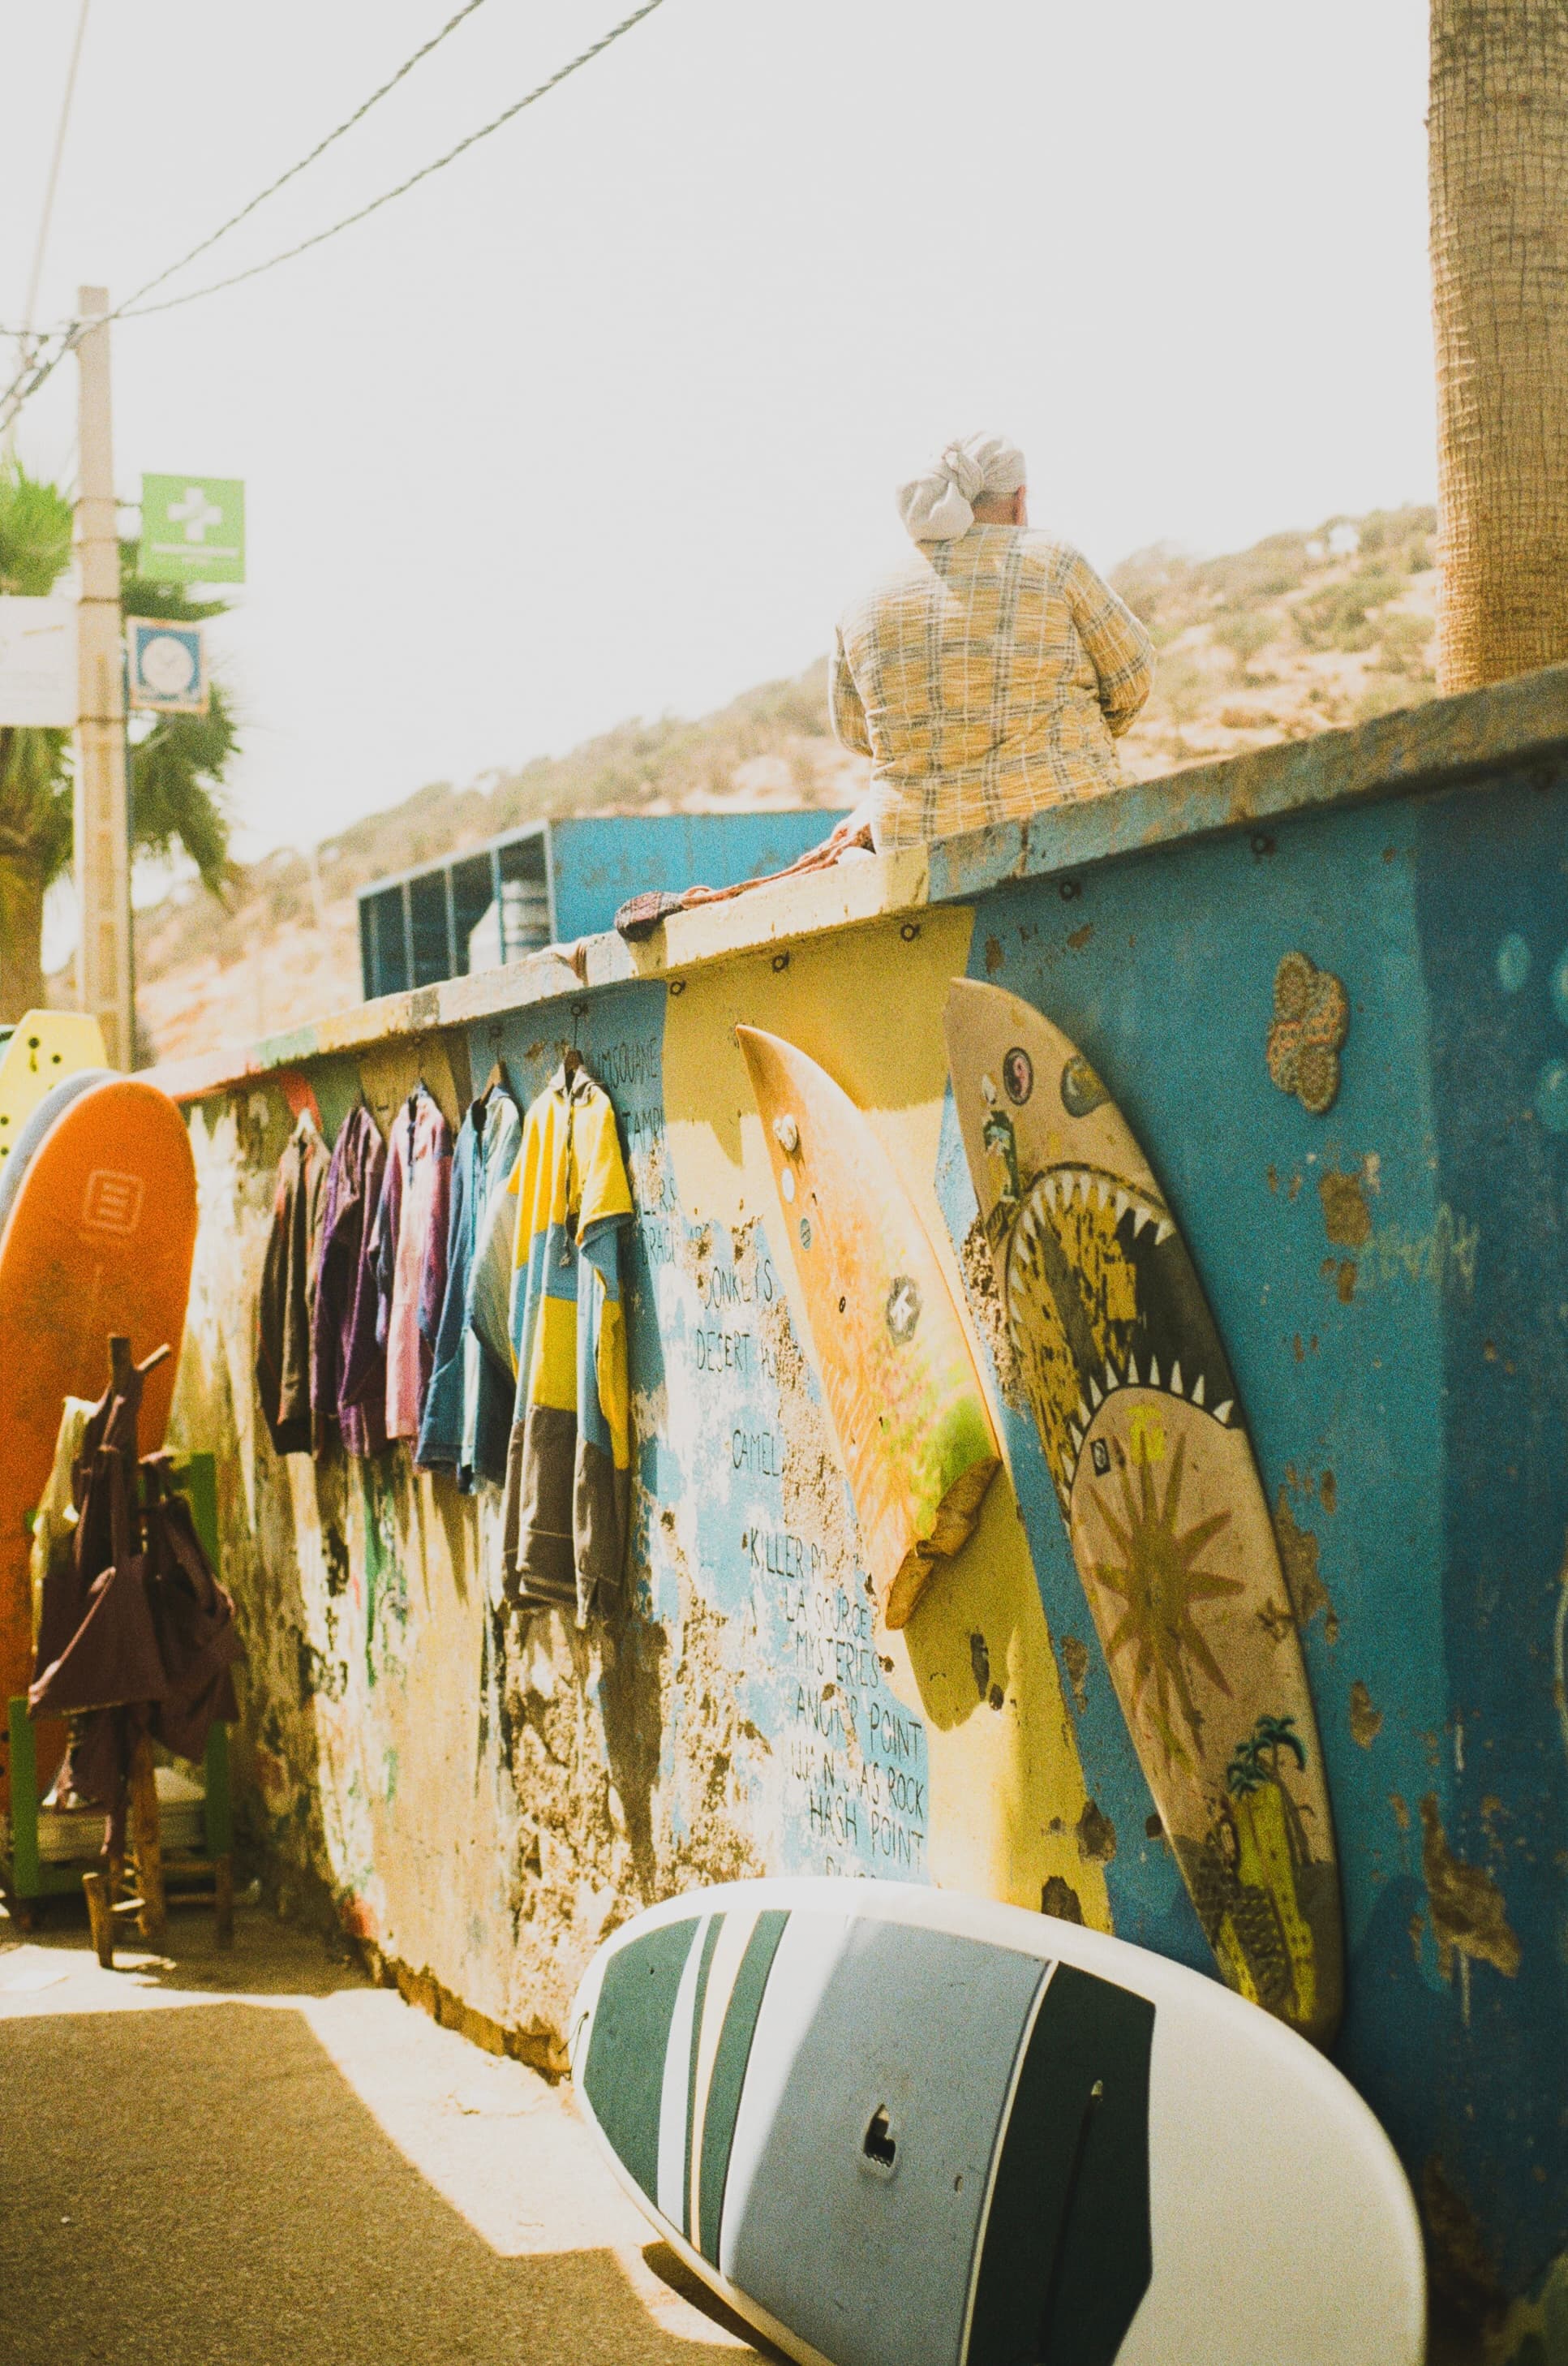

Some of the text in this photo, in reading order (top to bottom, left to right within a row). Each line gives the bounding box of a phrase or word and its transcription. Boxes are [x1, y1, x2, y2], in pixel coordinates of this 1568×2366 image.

[697, 1329, 750, 1374] DESERT
[732, 1429, 780, 1476] CAMEL
[750, 1527, 804, 1578] KILLER
[785, 1585, 869, 1641] LA SOURCE
[797, 1630, 879, 1688] MYSTERIES
[870, 1702, 922, 1762] POINT
[887, 1766, 925, 1822] ROCK
[810, 1788, 858, 1846] HASH
[870, 1811, 924, 1873] POINT
